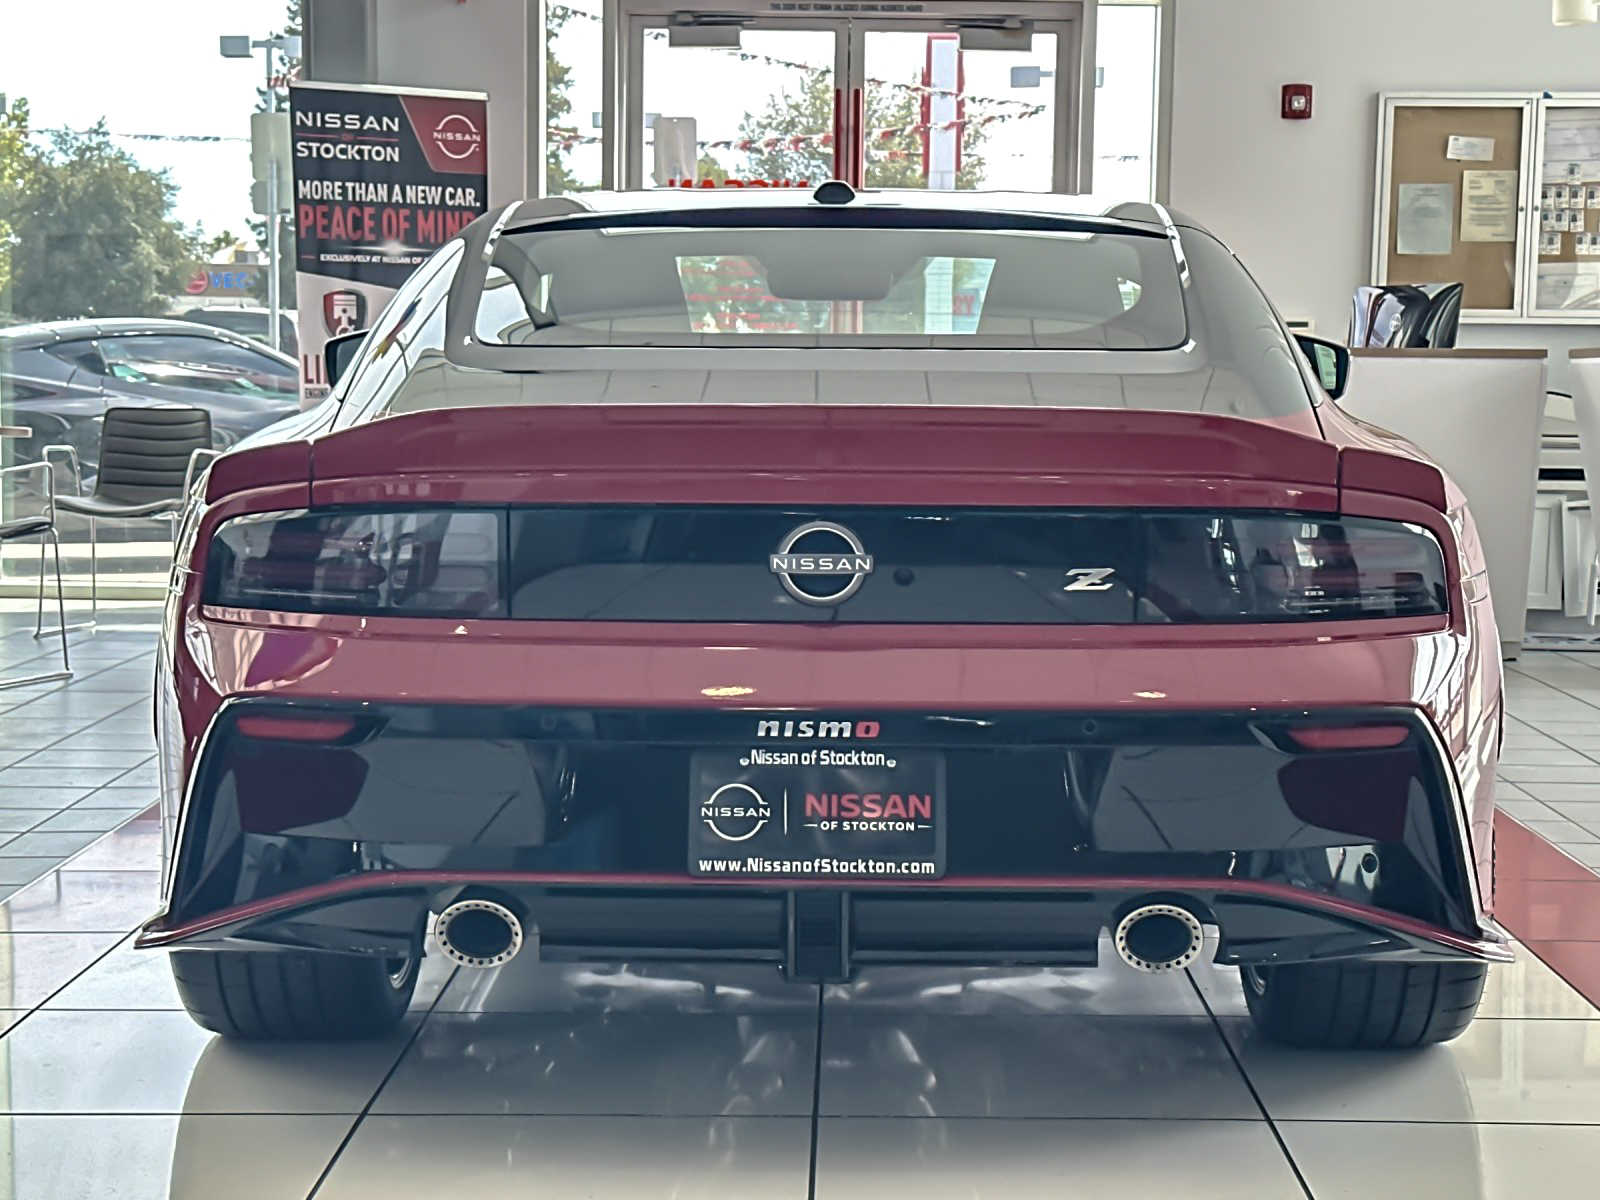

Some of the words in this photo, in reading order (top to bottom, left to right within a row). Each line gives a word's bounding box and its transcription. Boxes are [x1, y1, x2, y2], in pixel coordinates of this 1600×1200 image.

[295, 110, 400, 132] NISSAN
[433, 131, 481, 142] NISSAN
[296, 141, 400, 162] STOCKTON
[298, 179, 343, 201] MORE
[345, 182, 388, 203] THAN
[391, 184, 403, 204] A
[406, 185, 442, 206] NEW
[445, 187, 481, 207] CAR.
[299, 204, 376, 241] PEACE
[382, 207, 411, 241] OF
[773, 557, 871, 571] NISSAN
[1063, 567, 1115, 592] Z
[757, 719, 880, 738] nismo
[751, 749, 798, 766] Nissan
[801, 750, 817, 766] of
[819, 750, 885, 767] Stockton
[701, 807, 771, 817] NISSAN
[804, 793, 931, 820] NISSAN
[820, 821, 839, 831] OF
[842, 821, 915, 832] STOCKTON
[698, 857, 935, 875] www.NissanofStockton.com
